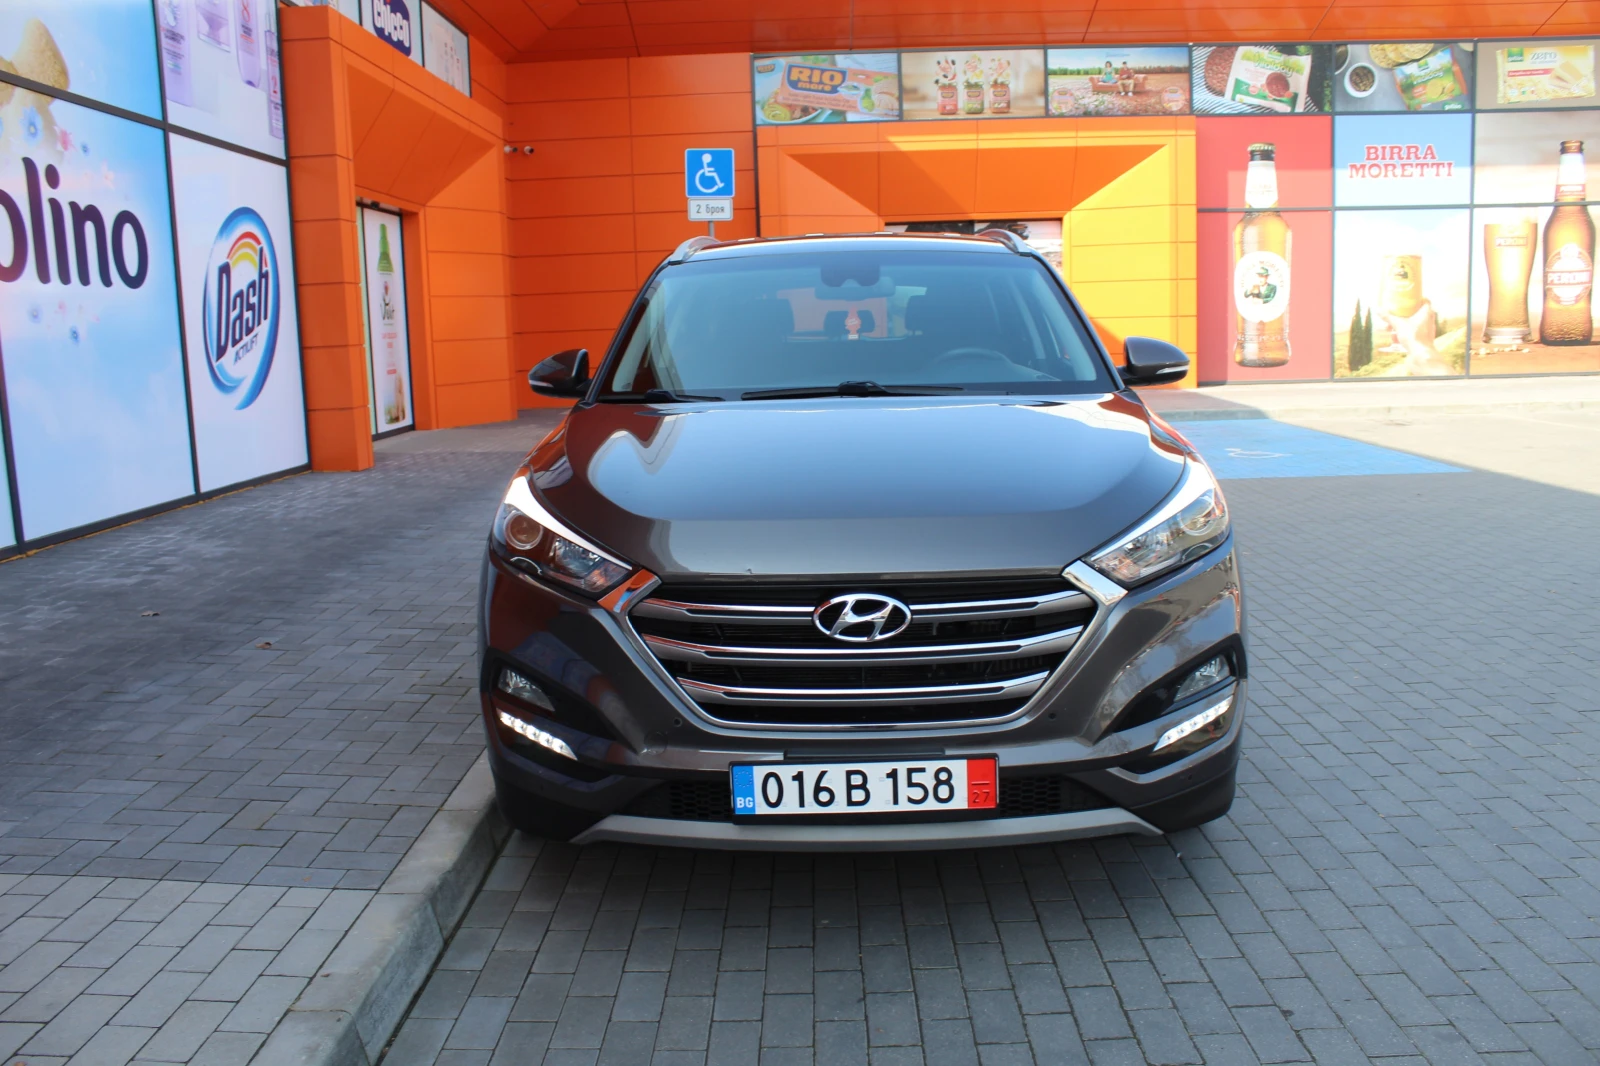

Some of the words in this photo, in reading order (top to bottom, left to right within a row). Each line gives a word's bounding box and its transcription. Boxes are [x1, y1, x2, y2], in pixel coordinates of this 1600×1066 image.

[790, 66, 843, 86] RIO
[798, 81, 832, 91] mare
[1365, 145, 1437, 161] BIRRA
[1349, 163, 1453, 178] MORETTI
[696, 204, 702, 214] 2
[705, 204, 725, 215] броя
[215, 246, 269, 363] Dash
[736, 797, 754, 808] BG
[972, 789, 990, 804] 27
